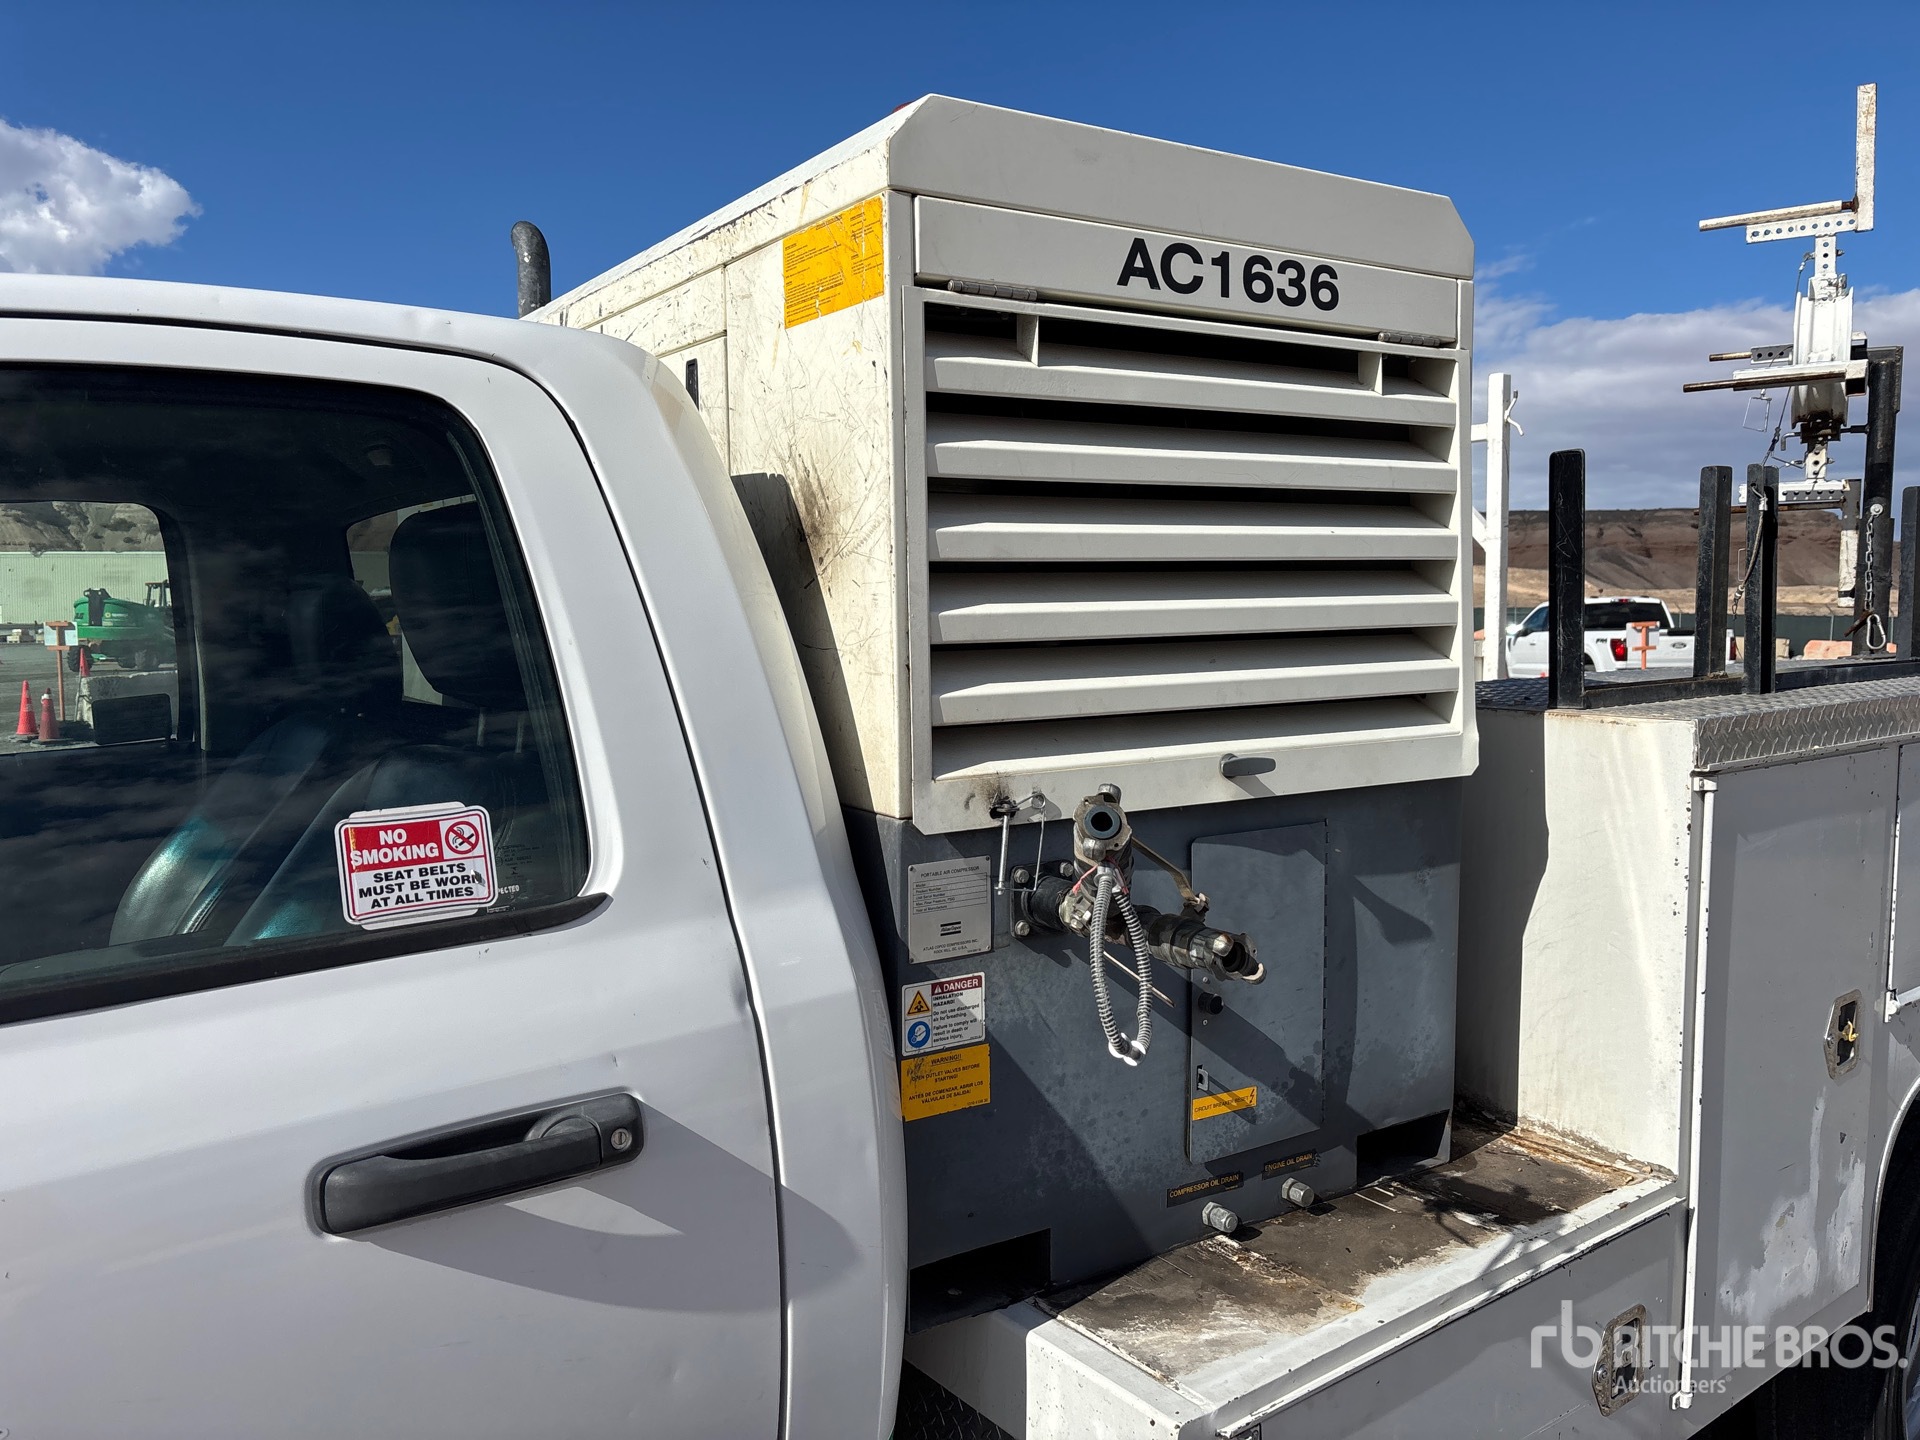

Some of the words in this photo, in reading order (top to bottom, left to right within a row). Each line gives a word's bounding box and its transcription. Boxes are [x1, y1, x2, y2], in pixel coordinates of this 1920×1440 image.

[1116, 237, 1340, 311] AC1636
[379, 828, 407, 845] NO
[350, 842, 440, 867] SMOKING
[373, 869, 414, 883] SEAT
[418, 863, 466, 878] BELTS
[920, 870, 942, 878] PORTABLE
[951, 866, 980, 874] COMPRESSOR
[358, 883, 406, 899] MUST
[410, 879, 432, 891] BE
[370, 896, 392, 909] AT
[394, 893, 424, 906] ALL
[426, 886, 475, 901] TIMES
[943, 978, 979, 992] DANGER
[933, 992, 964, 1001] INHALATION
[933, 999, 955, 1008] HAZARD!
[956, 1003, 980, 1012] discharged
[930, 1054, 962, 1066] WARNING!!
[912, 1074, 925, 1082] OPEN
[926, 1070, 943, 1079] OUTLET
[944, 1067, 962, 1075] VALVES
[962, 1063, 980, 1072] BEFORE
[934, 1074, 958, 1083] STARTING!
[908, 1092, 924, 1100] ANTES
[959, 1082, 974, 1090] ABRIR
[953, 1089, 972, 1098] SALIDA!
[1194, 1103, 1212, 1112] CIRCUIT
[1212, 1100, 1234, 1109] BREAKER
[1234, 1096, 1249, 1104] RESET
[1264, 1160, 1286, 1172] ENGINE
[1286, 1158, 1296, 1166] OIL
[1296, 1152, 1313, 1164] DRAIN
[1170, 1181, 1210, 1198] COMPRESSOR
[1210, 1179, 1220, 1187] OIL
[1220, 1174, 1239, 1184] DRAIN
